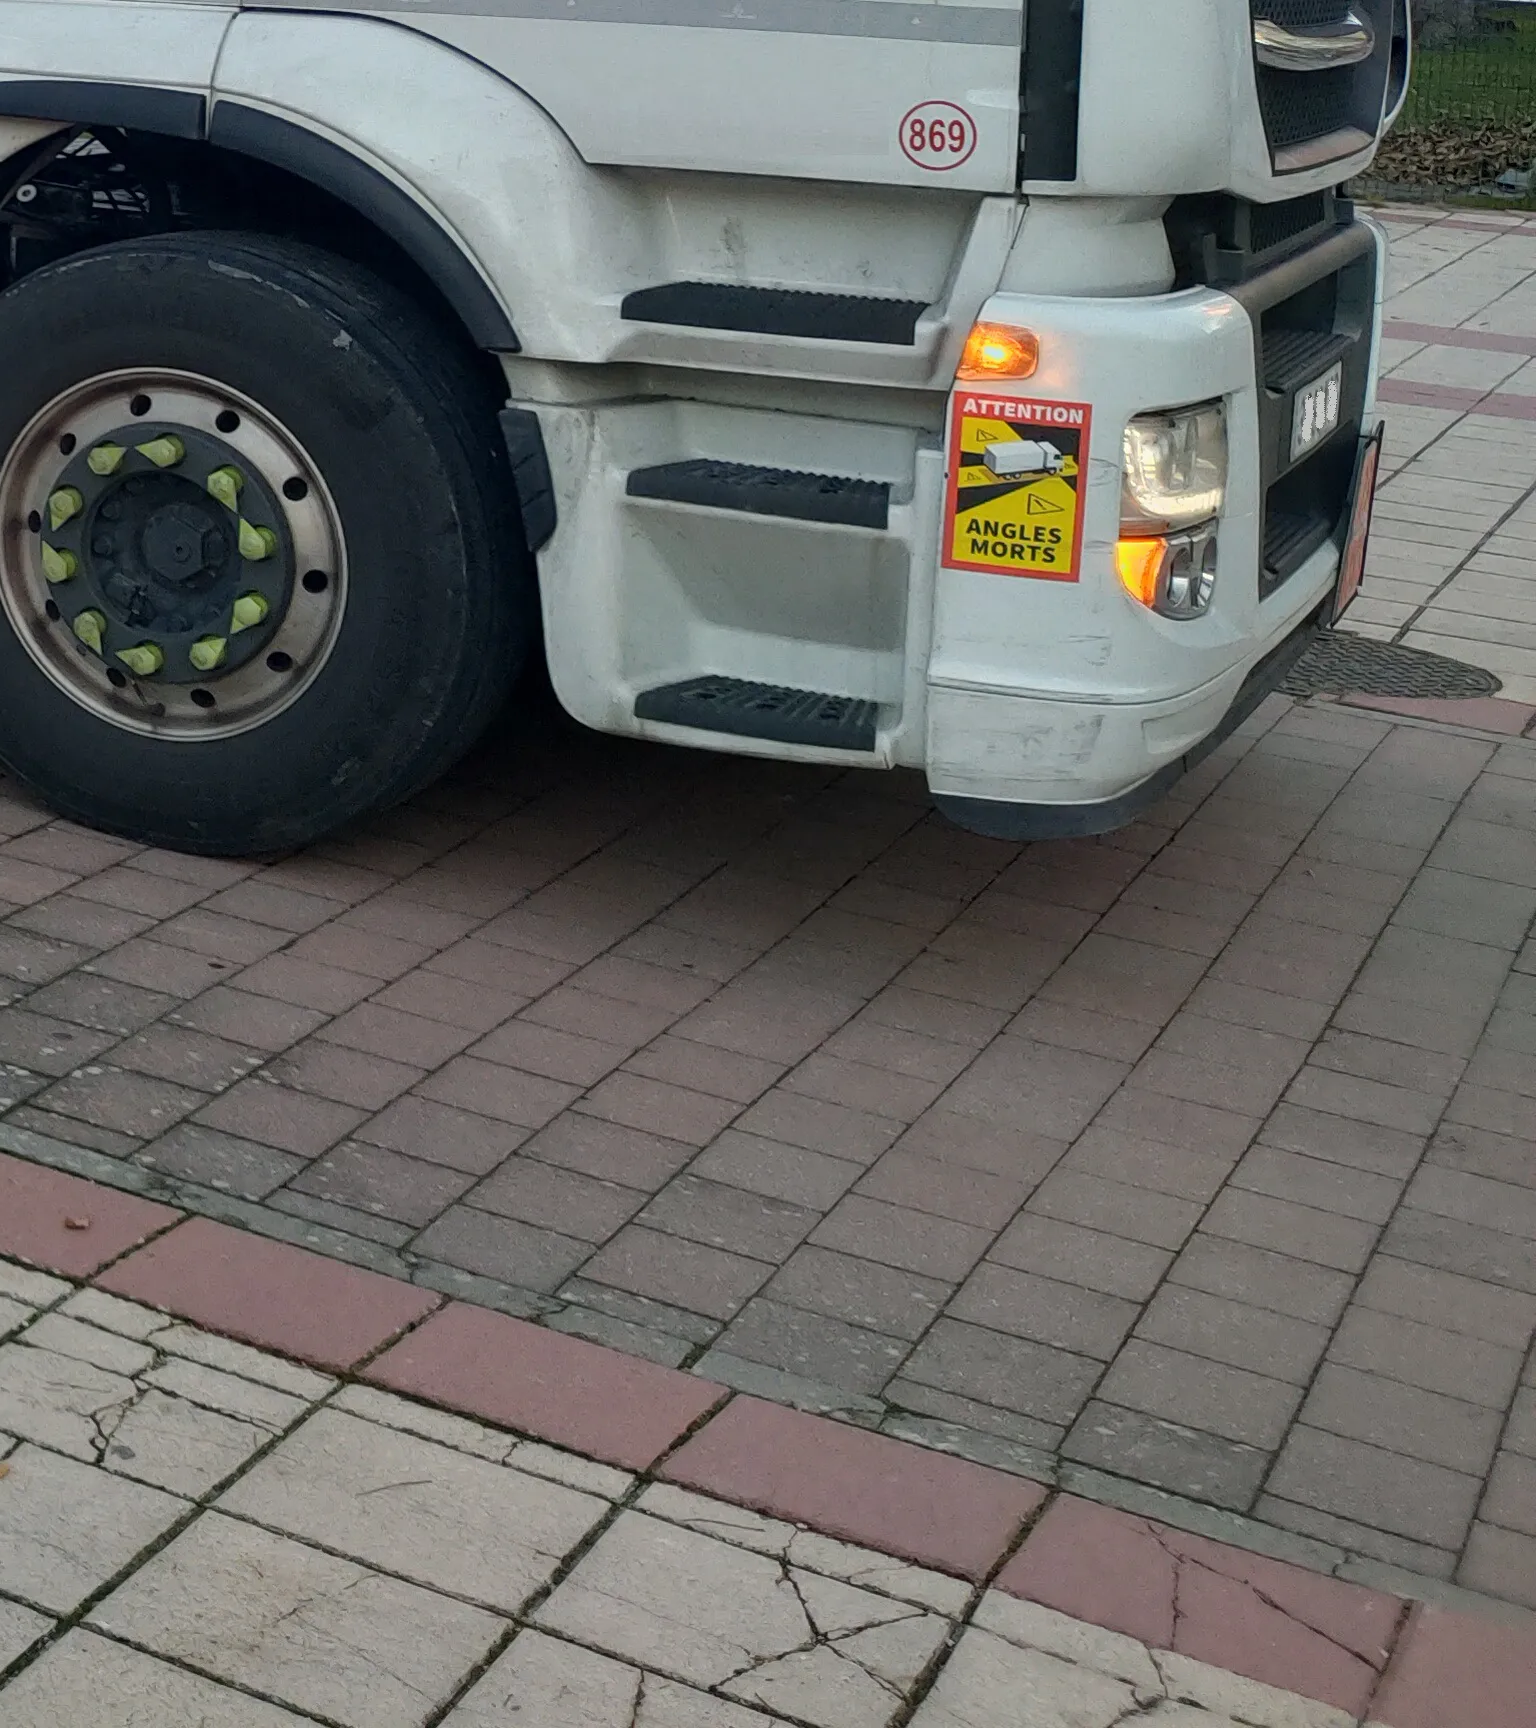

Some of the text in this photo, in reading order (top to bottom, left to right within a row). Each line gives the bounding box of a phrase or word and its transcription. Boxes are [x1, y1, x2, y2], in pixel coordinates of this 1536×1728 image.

[909, 118, 966, 153] 869
[963, 397, 1084, 424] ATTENTION
[966, 518, 1062, 544] ANGLES
[970, 538, 1056, 563] MORTS
